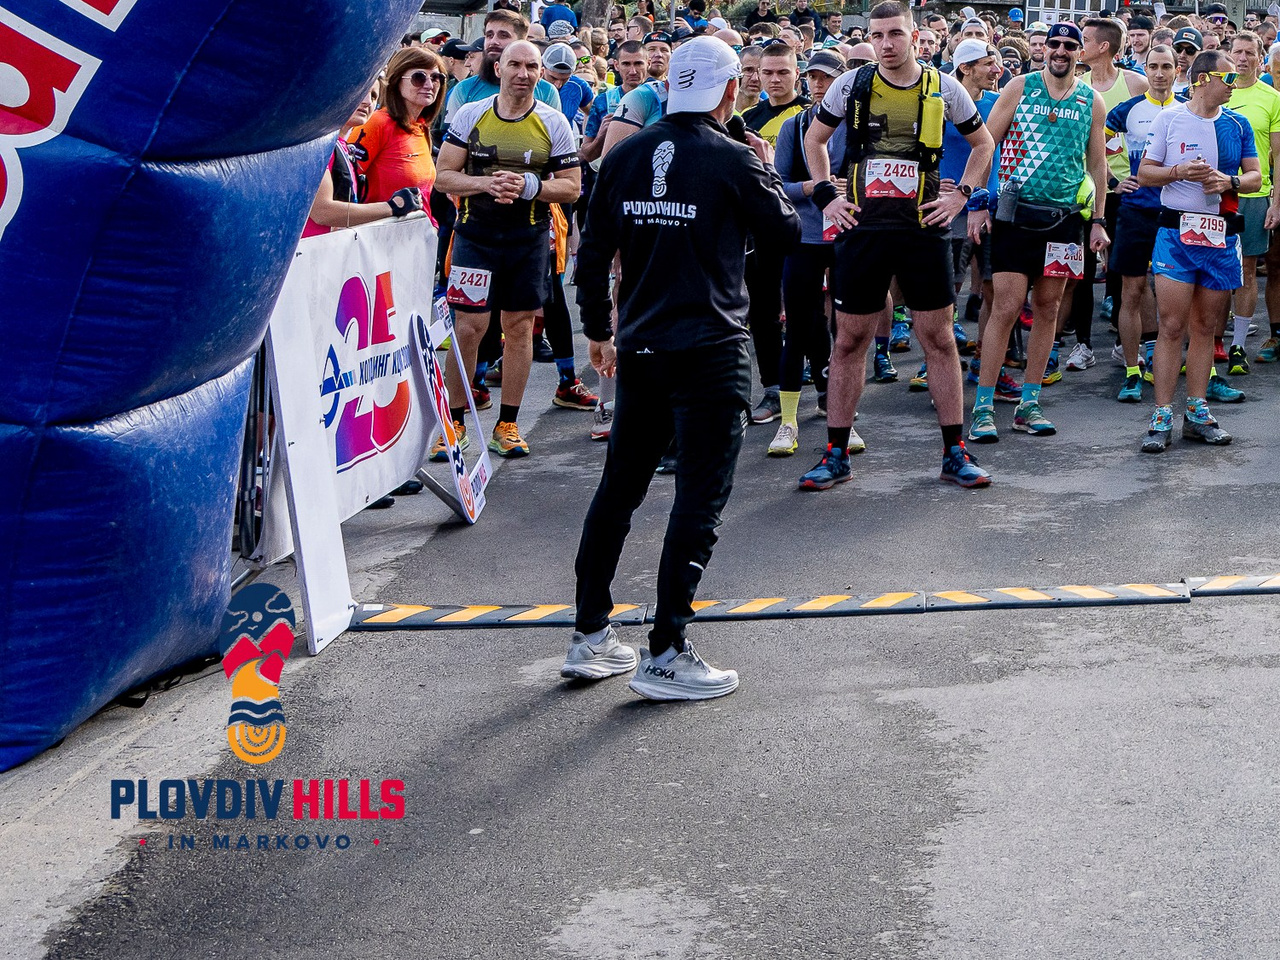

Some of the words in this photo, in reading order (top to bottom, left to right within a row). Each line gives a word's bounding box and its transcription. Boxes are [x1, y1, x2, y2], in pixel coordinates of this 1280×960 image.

[883, 162, 916, 178] 2420
[1199, 216, 1225, 233] 2199
[459, 271, 488, 288] 2421
[644, 664, 676, 681] HOKA
